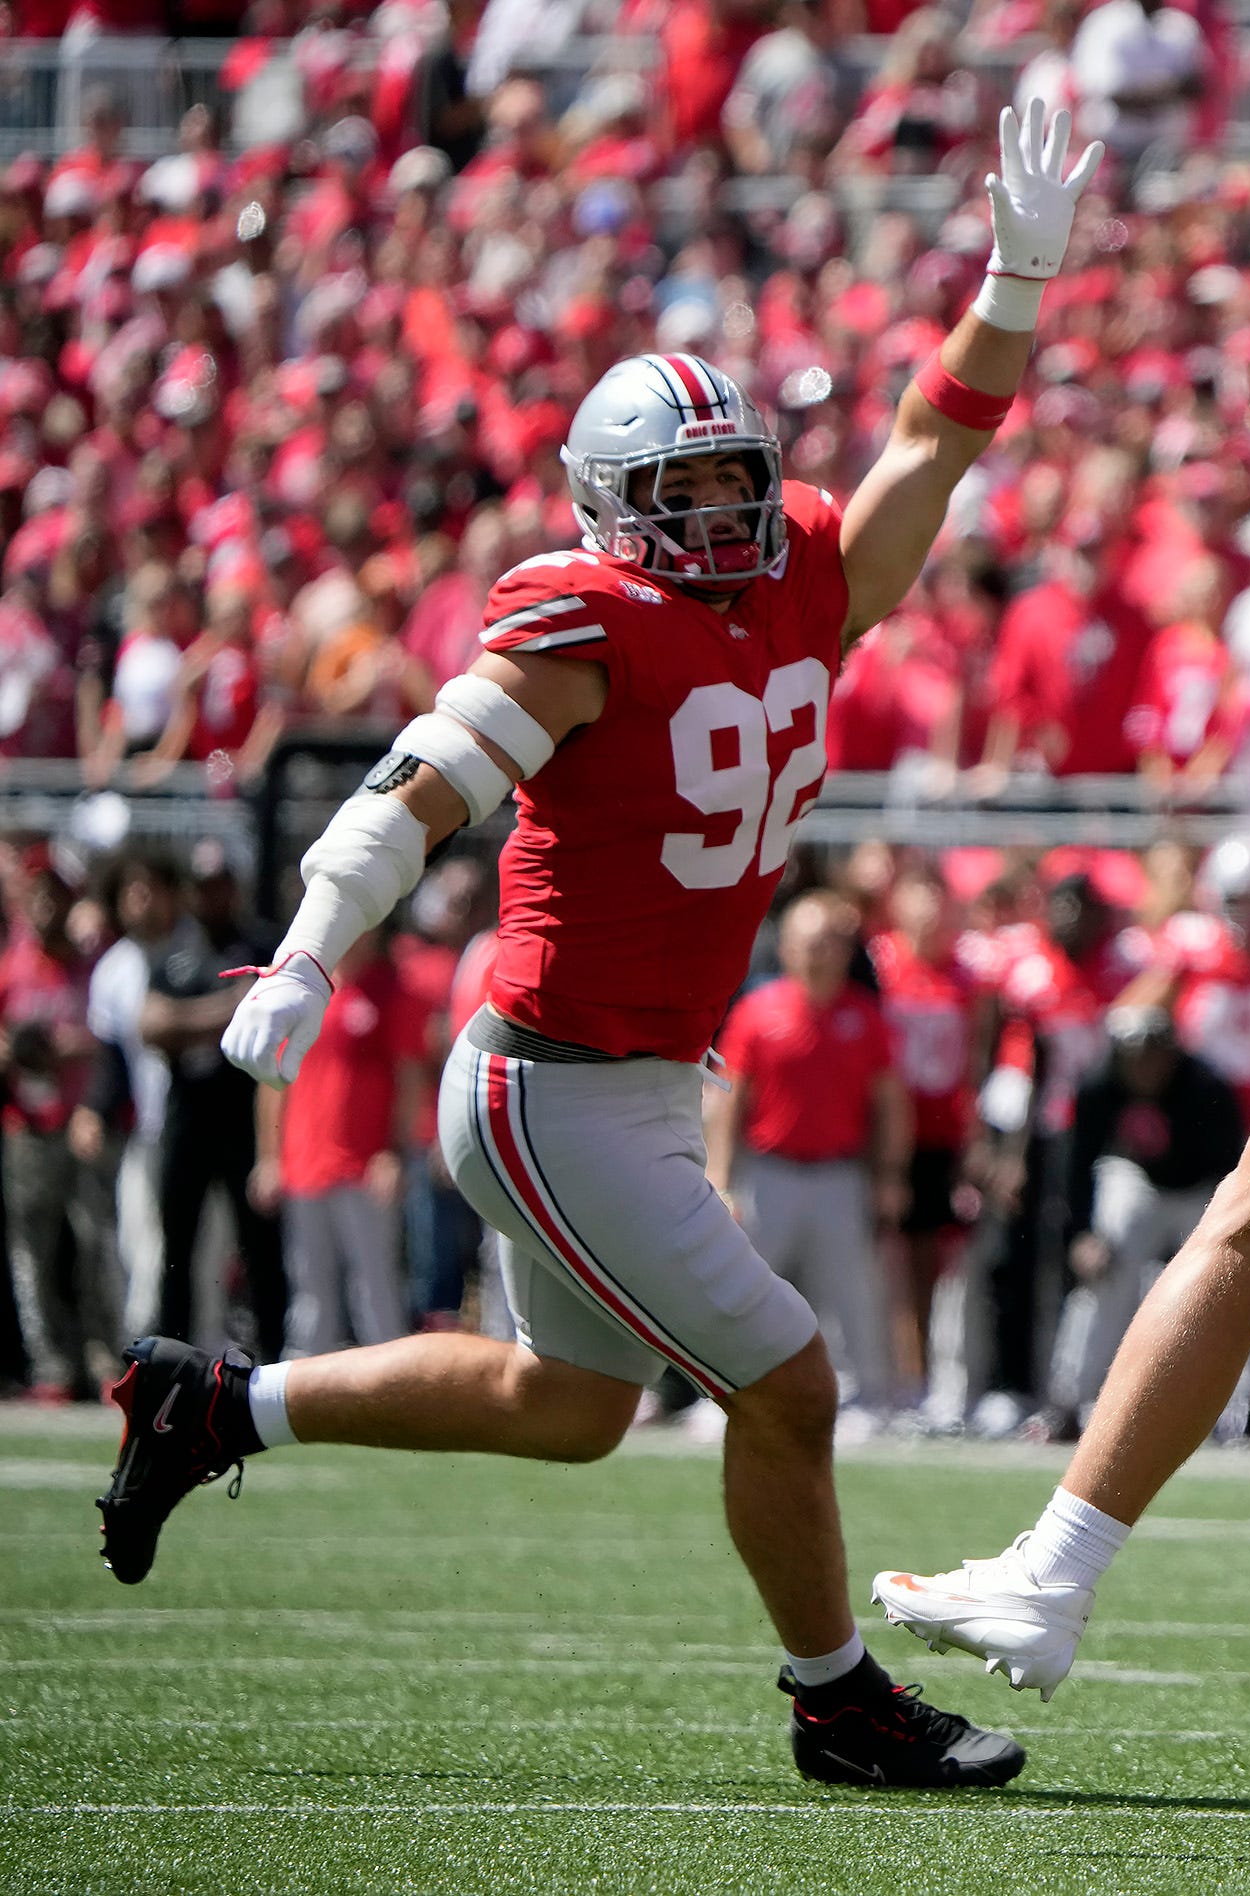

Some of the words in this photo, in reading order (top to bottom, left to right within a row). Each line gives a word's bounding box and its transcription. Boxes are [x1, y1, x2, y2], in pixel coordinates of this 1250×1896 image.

[685, 425, 708, 439] OHIO
[711, 422, 737, 436] STATE
[660, 656, 830, 889] 92
